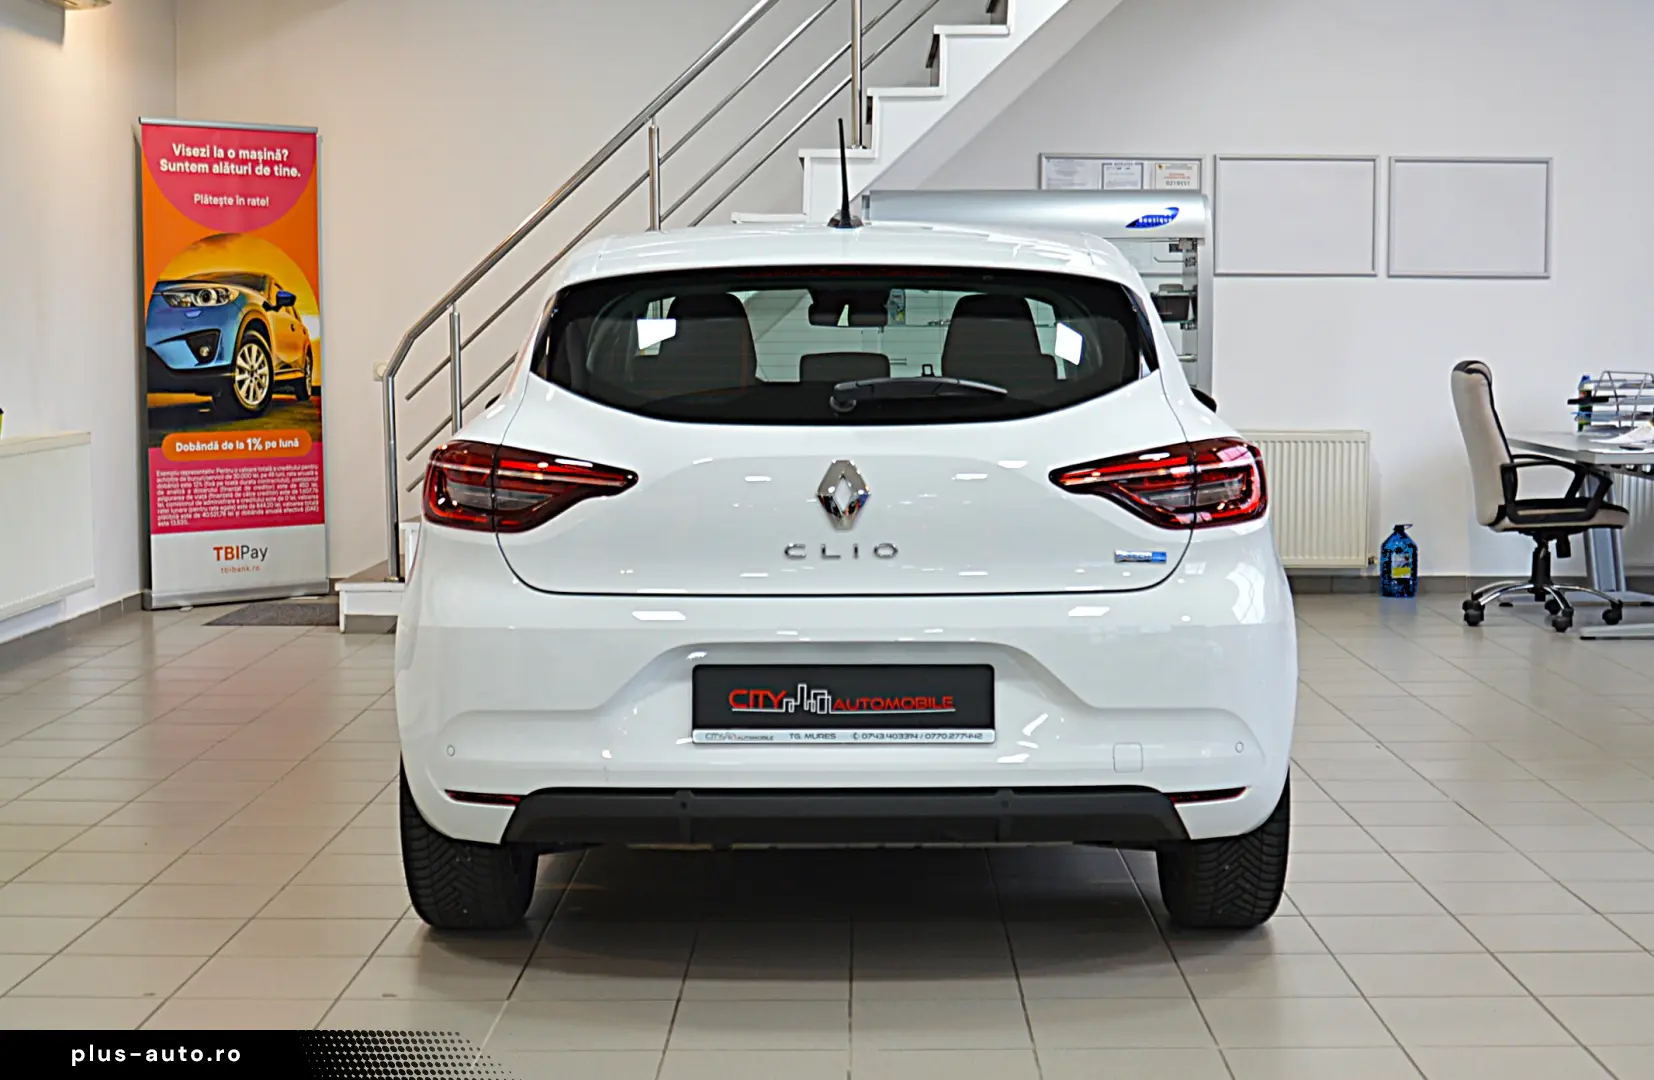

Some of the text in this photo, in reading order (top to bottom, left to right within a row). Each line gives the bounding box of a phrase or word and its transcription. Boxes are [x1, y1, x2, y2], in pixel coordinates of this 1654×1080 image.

[172, 144, 210, 158] Visezi
[214, 146, 224, 158] la
[227, 150, 236, 159] o
[160, 159, 301, 178] Suntem alături de tine.
[236, 195, 246, 206] în
[221, 440, 234, 450] de
[236, 440, 244, 450] la
[246, 438, 262, 451] 1%
[265, 440, 278, 451] pe
[279, 437, 300, 449] lună
[213, 545, 268, 562] TBIPay
[784, 542, 899, 560] CLIO
[729, 689, 955, 710] CITY AUTOMOBILE
[804, 732, 837, 740] MURES
